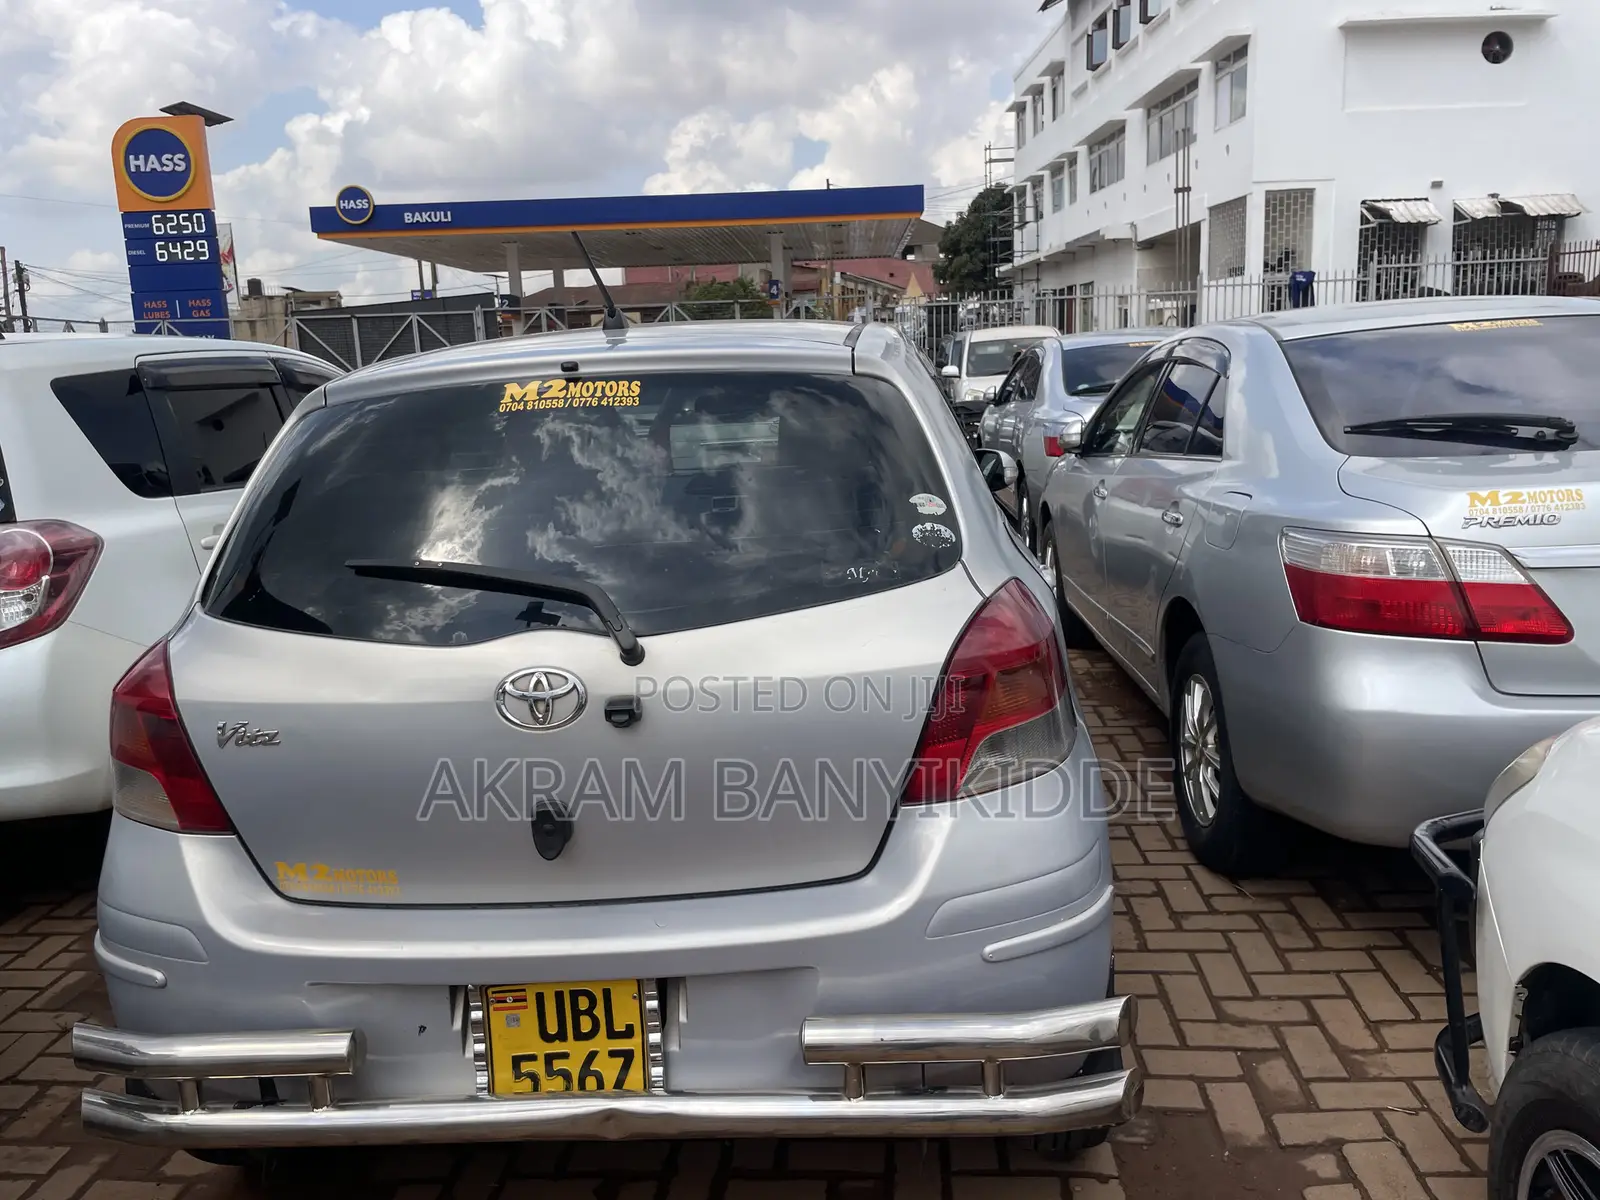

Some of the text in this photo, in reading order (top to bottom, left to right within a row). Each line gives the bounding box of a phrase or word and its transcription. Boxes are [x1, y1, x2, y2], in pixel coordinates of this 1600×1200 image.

[129, 153, 187, 173] HASS
[340, 199, 369, 209] HASS
[152, 213, 206, 234] 6250
[403, 211, 452, 223] BAKULI
[155, 240, 209, 261] 6429
[770, 285, 778, 295] 4
[143, 300, 168, 308] HASS
[188, 299, 212, 307] HASS
[143, 311, 171, 319] LUBES
[500, 378, 641, 403] M2 MOTORS
[499, 401, 524, 413] 0704
[526, 399, 564, 410] 810558
[572, 397, 599, 408] 0776
[601, 396, 640, 407] 412393
[1466, 488, 1584, 507] M2 MOTORS
[1468, 508, 1490, 517] 0704
[1530, 504, 1552, 512] 0776
[1461, 513, 1561, 529] PREMIO
[217, 720, 281, 749] Vitz
[535, 987, 635, 1044] UBL
[511, 1047, 635, 1093] 5567
